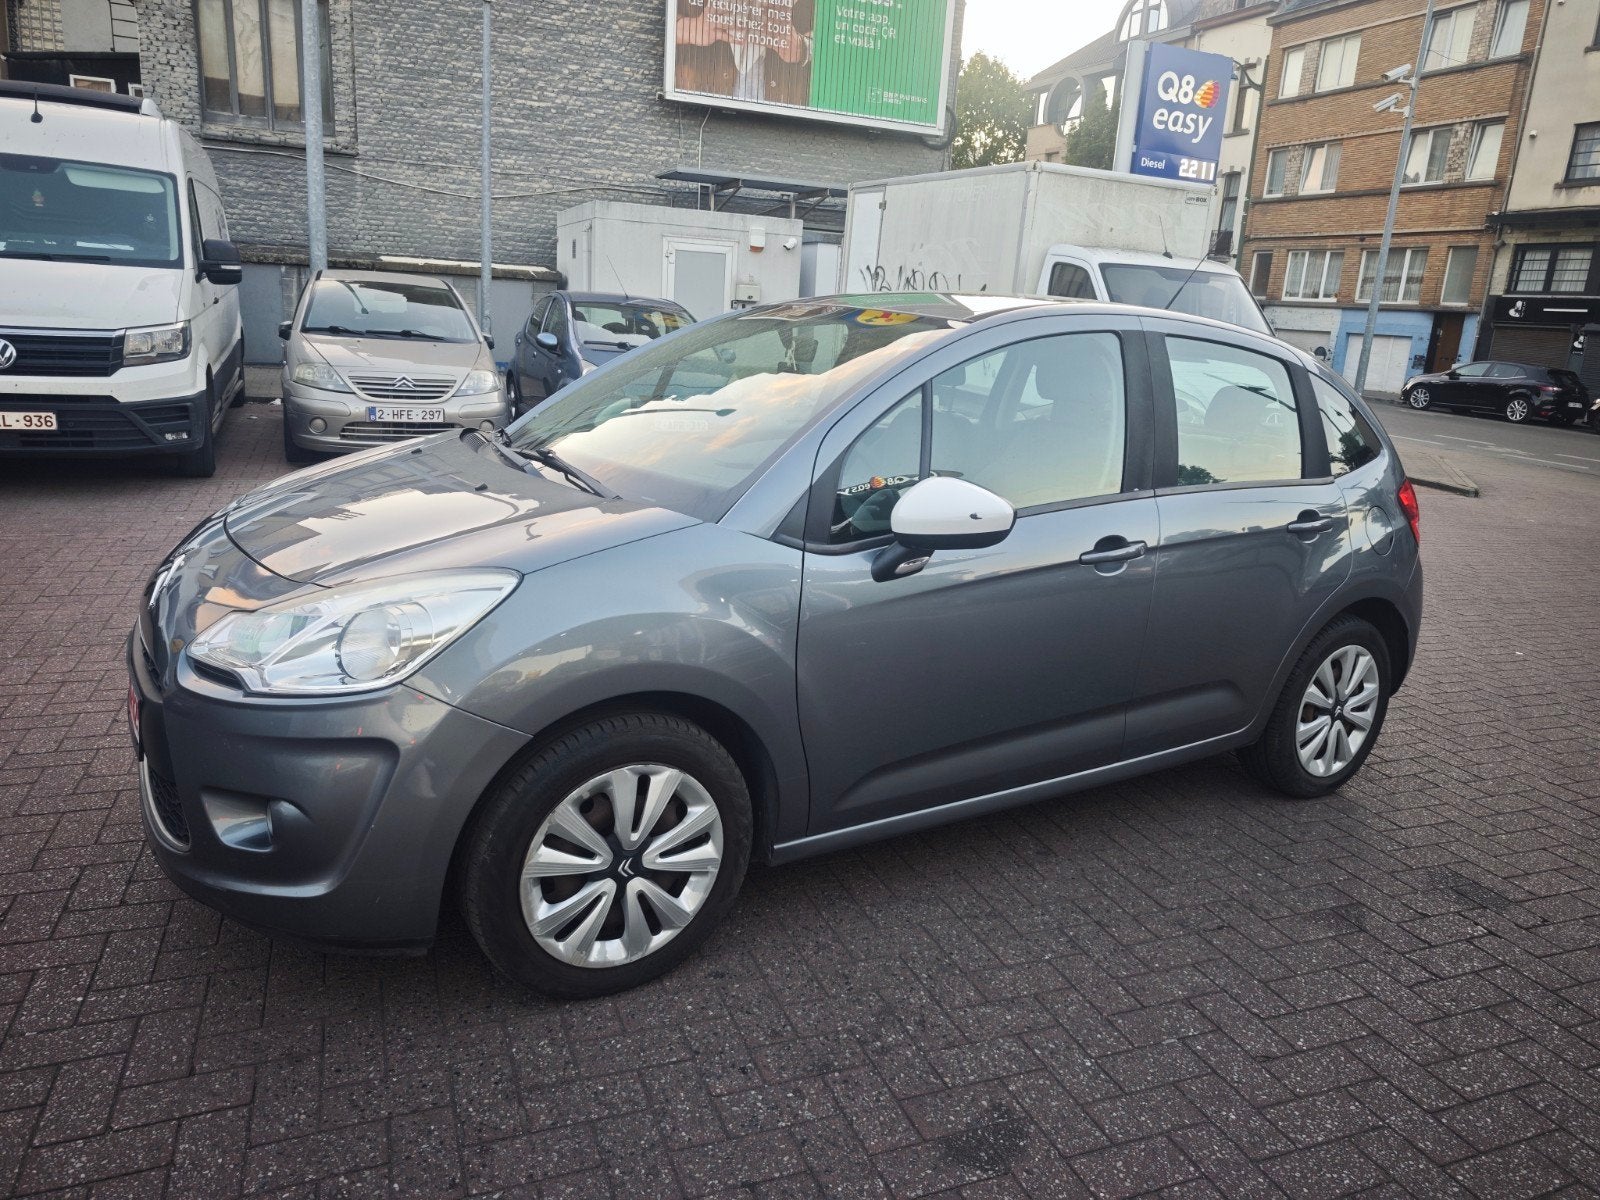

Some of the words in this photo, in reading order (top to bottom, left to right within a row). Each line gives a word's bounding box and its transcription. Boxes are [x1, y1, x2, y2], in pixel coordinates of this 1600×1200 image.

[767, 8, 792, 21] mes
[836, 5, 866, 21] Votre
[706, 13, 734, 26] sous
[737, 17, 764, 31] chez
[767, 22, 792, 35] tout
[835, 21, 849, 31] un
[881, 26, 896, 40] QR
[834, 33, 846, 45] et
[1157, 70, 1196, 104] Q8
[1152, 107, 1213, 144] easy
[1140, 157, 1166, 170] Diesel
[0, 414, 54, 428] L-936
[377, 409, 442, 420] 2-HFE-297
